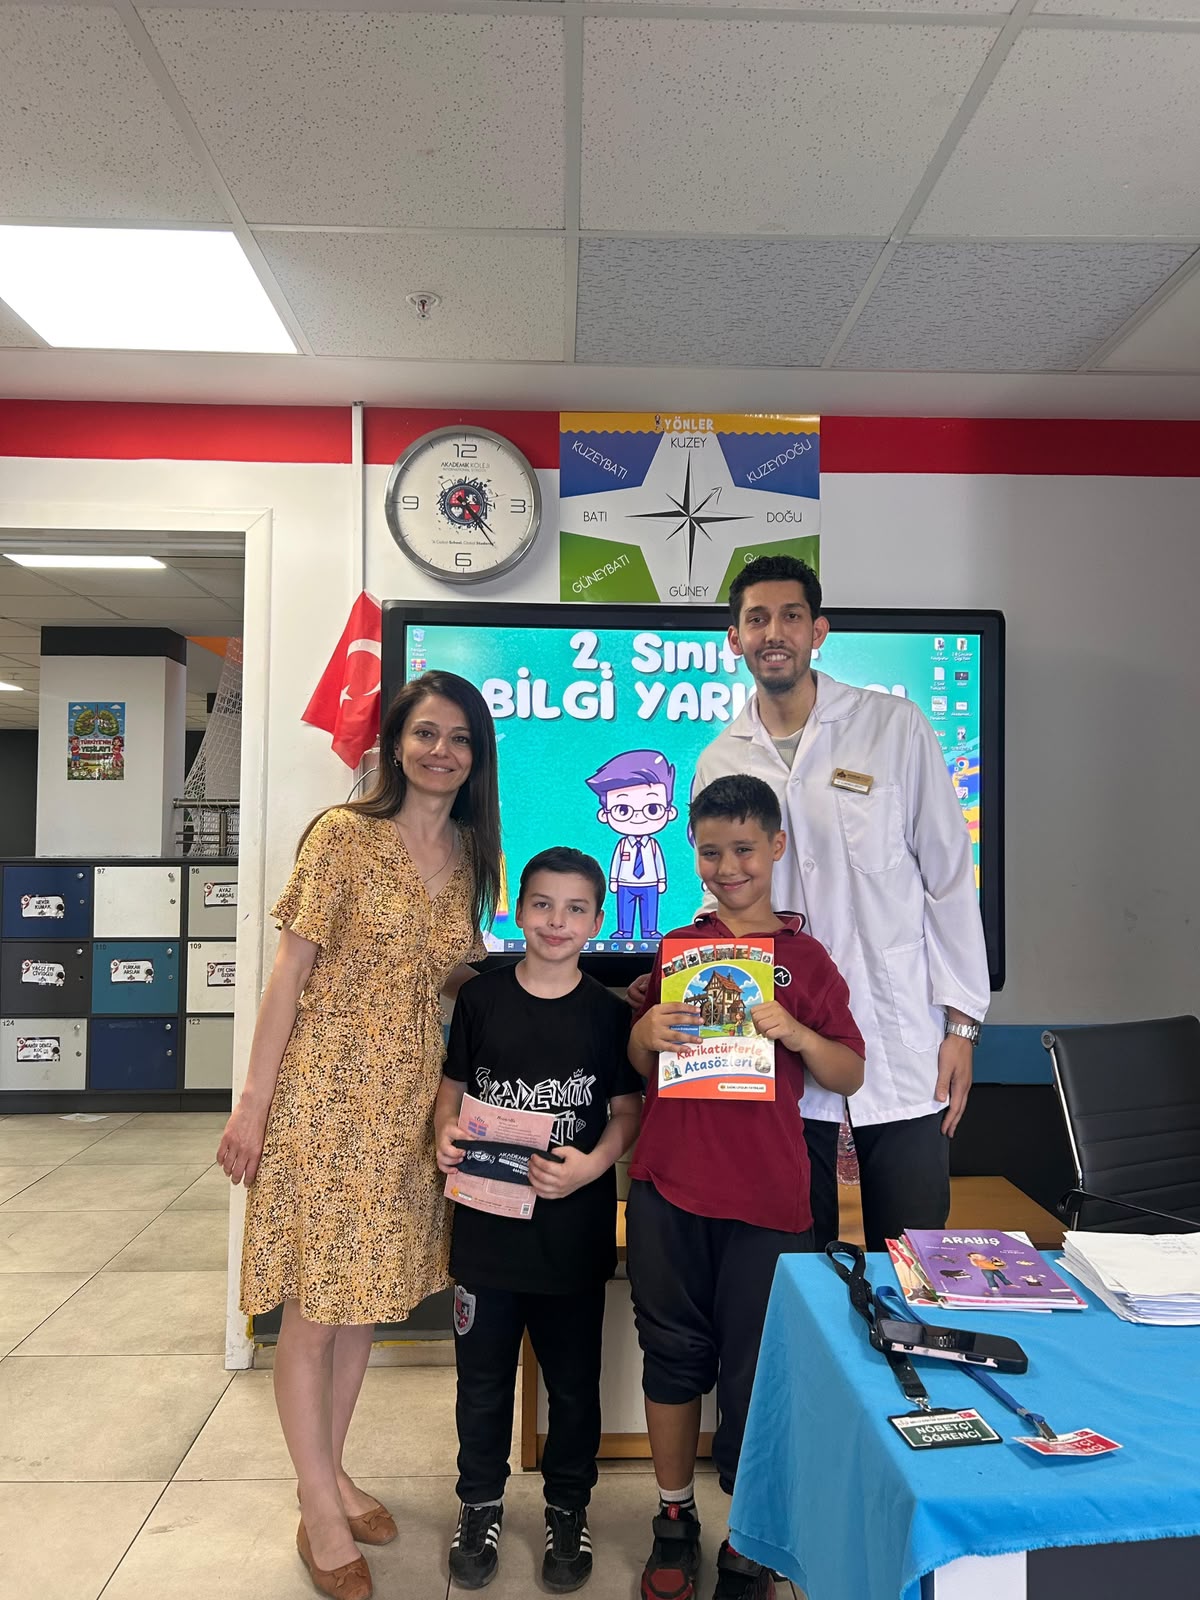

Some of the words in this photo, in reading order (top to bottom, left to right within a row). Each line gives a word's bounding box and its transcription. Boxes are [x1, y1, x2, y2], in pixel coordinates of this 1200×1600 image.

[664, 416, 714, 431] YÖNLER
[453, 443, 478, 458] 12
[670, 437, 707, 449] KUZEY
[572, 440, 628, 480] KUZEYBATI
[746, 439, 812, 484] KUZEYDOĞU
[402, 495, 419, 510] 9
[510, 499, 526, 514] 3
[583, 511, 608, 522] BATI
[766, 510, 803, 523] DOĞU
[455, 552, 472, 567] 6
[572, 554, 630, 593] GÜNEYBATI
[669, 584, 710, 597] GÜNEY
[570, 631, 611, 670] 2.
[481, 667, 615, 721] BİLGİ
[684, 1055, 753, 1074] Atasözleri
[915, 1420, 973, 1435] NÖBETÇİ
[922, 1430, 982, 1443] ÖĞRENCİ
